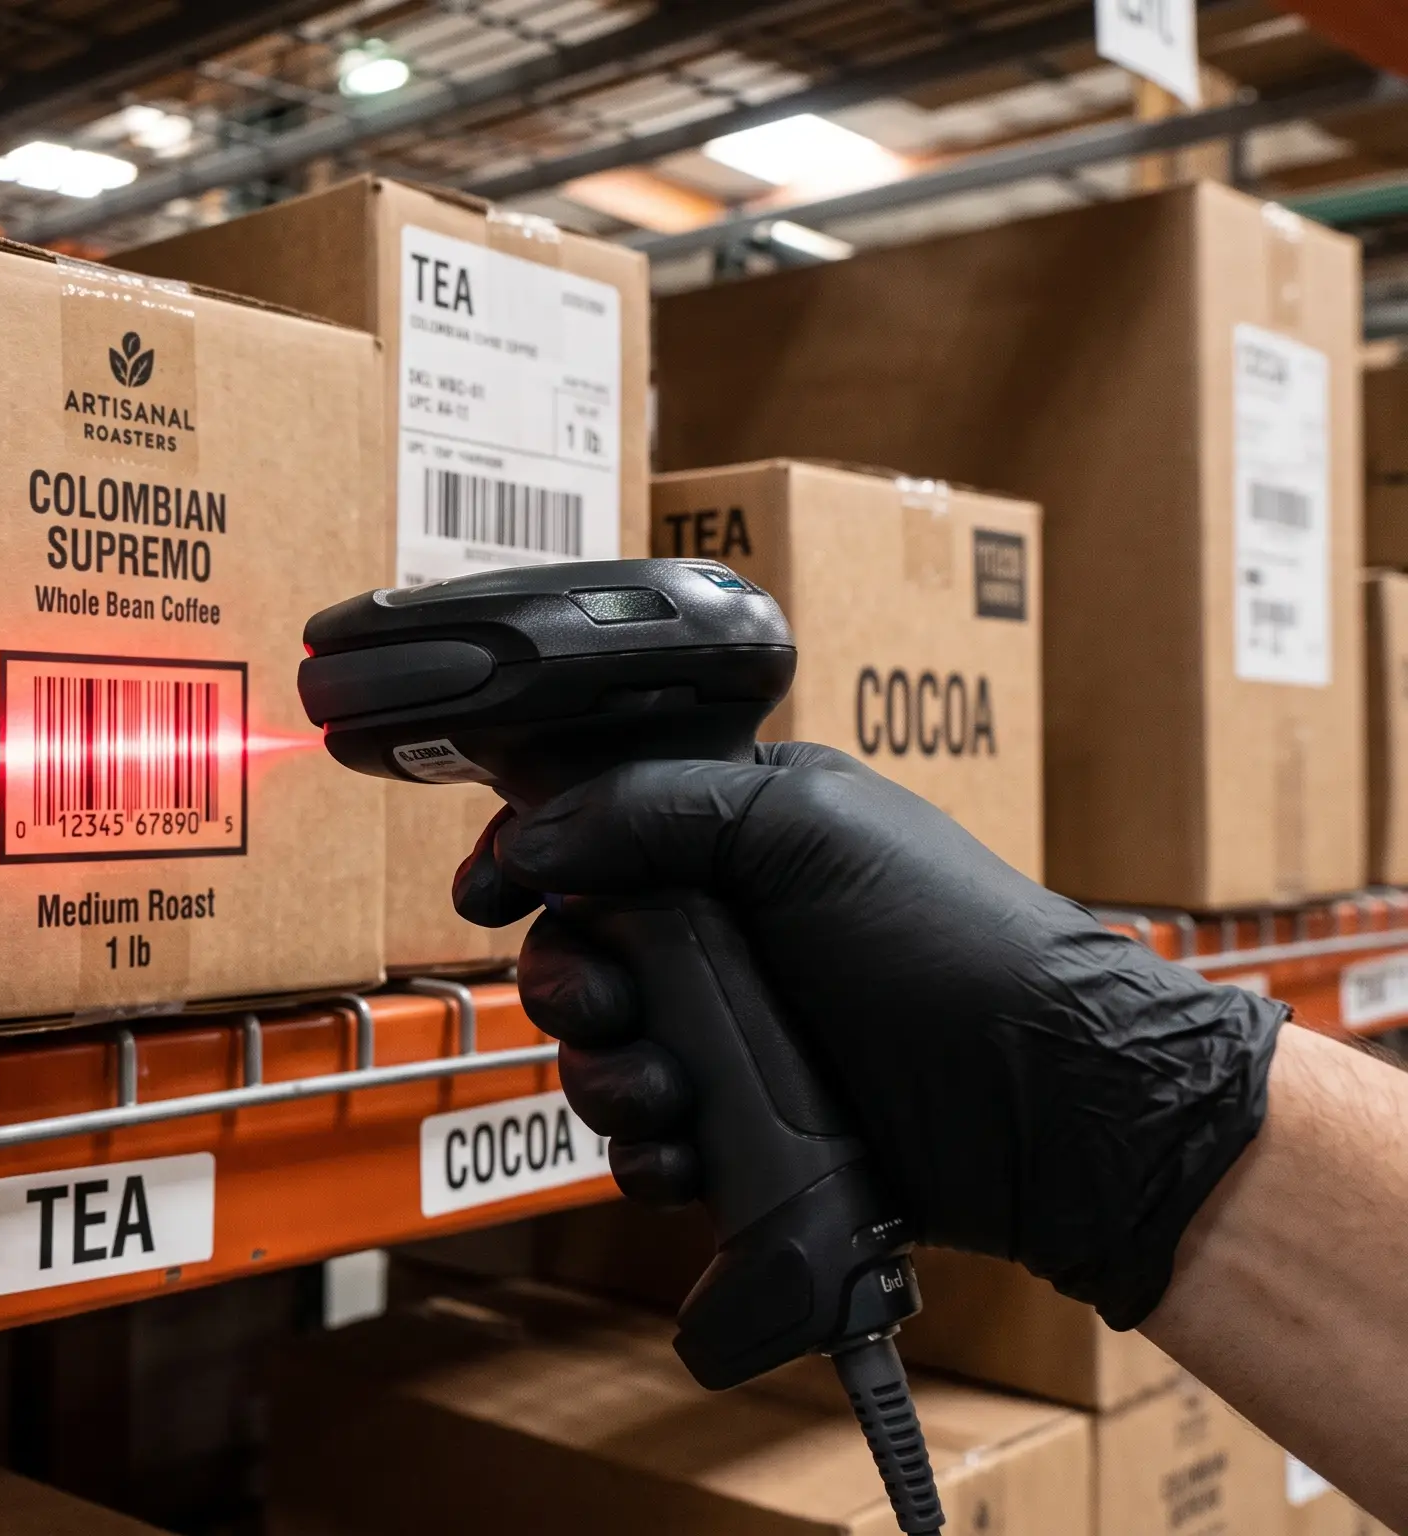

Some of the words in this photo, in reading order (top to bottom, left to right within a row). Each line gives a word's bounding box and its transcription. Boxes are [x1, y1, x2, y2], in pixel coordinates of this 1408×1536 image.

[411, 253, 475, 317] TEA
[64, 390, 196, 431] ARTISANAL
[84, 423, 177, 452] ROASTERS
[29, 469, 226, 534] COLOMBIAN
[47, 525, 212, 583] SUPREMO
[665, 507, 753, 558] TEA
[34, 584, 100, 616] Whole
[106, 590, 155, 620] Bean
[161, 595, 221, 625] Coffee
[856, 665, 997, 757] COCOA
[15, 820, 27, 839] 0
[58, 813, 125, 838] 12345
[135, 812, 200, 836] 67890
[224, 816, 234, 834] 5
[37, 891, 140, 928] Medium
[148, 888, 216, 921] Roast
[105, 936, 117, 969] 1
[128, 934, 152, 968] lb
[445, 1107, 575, 1190] COCOA
[26, 1174, 155, 1270] TEA
